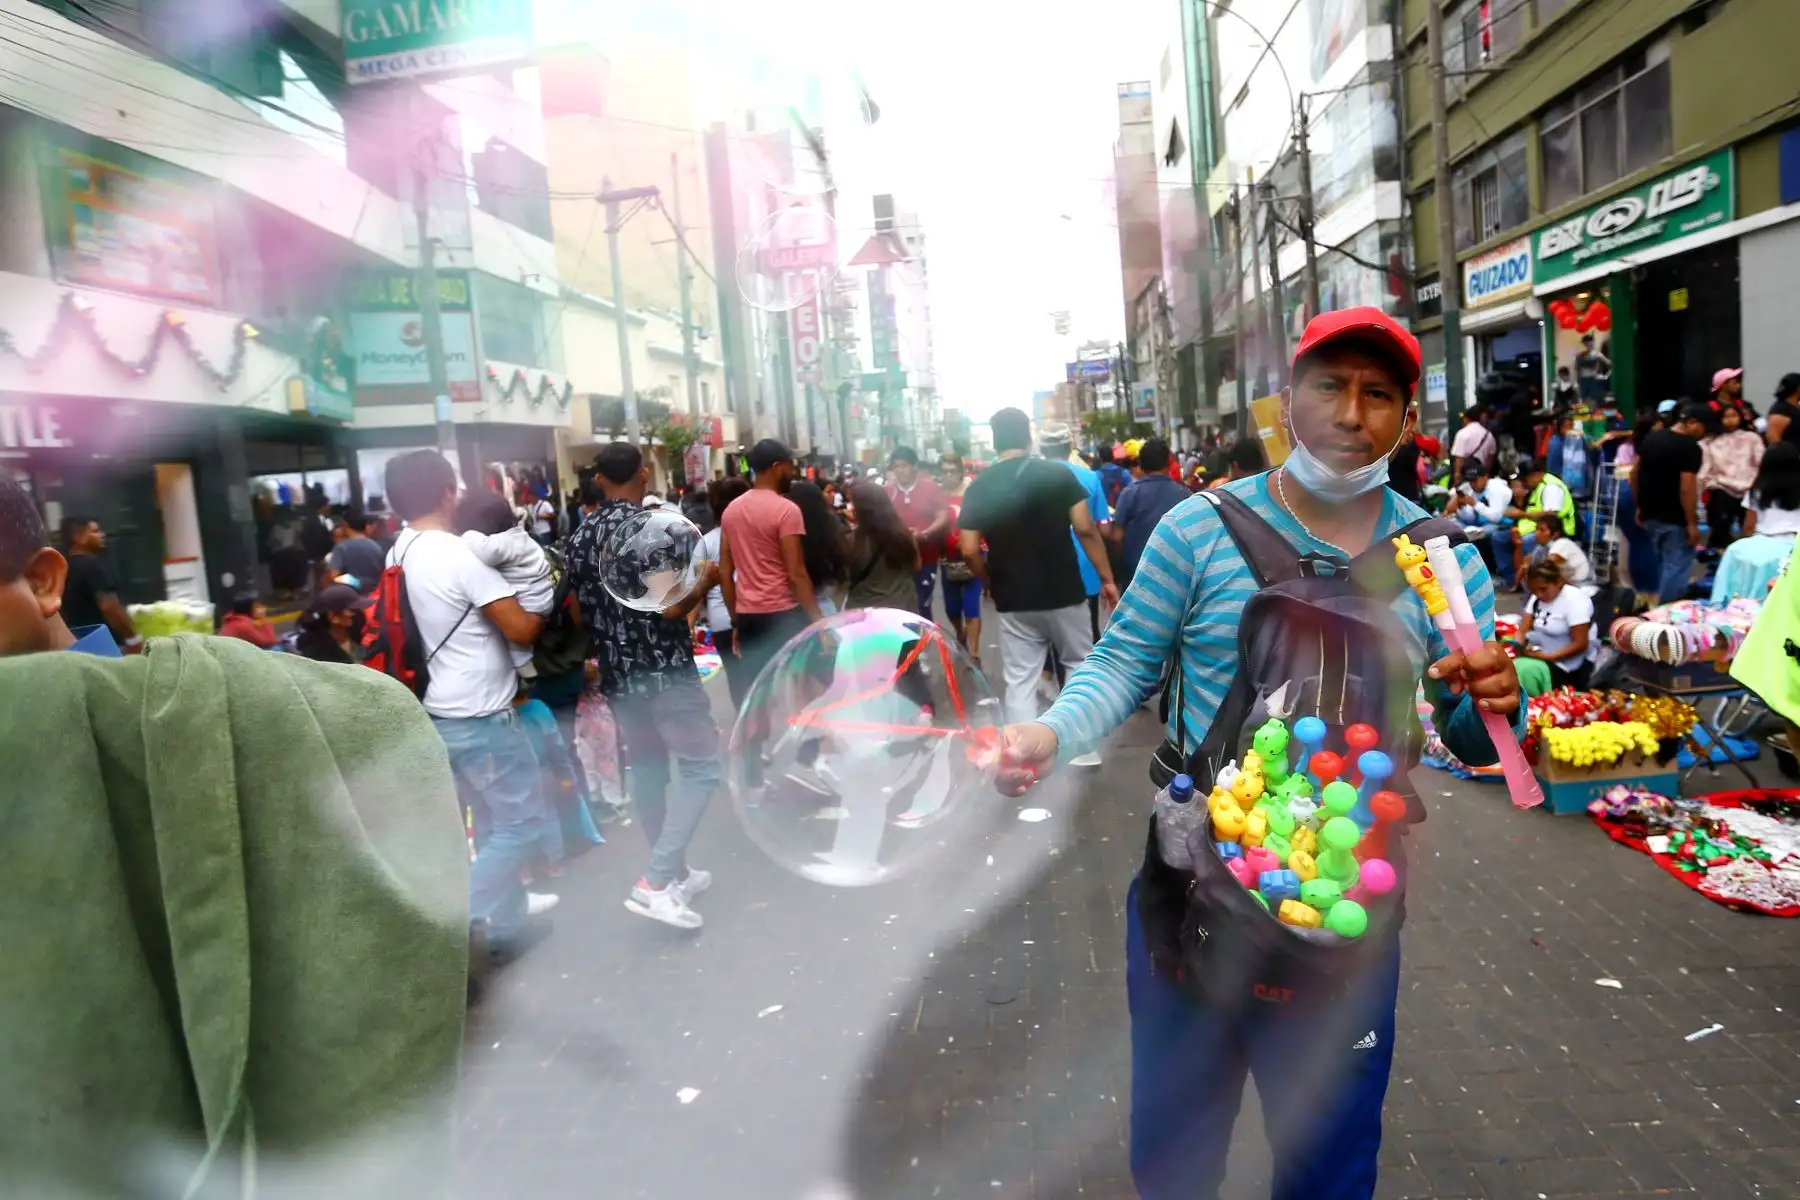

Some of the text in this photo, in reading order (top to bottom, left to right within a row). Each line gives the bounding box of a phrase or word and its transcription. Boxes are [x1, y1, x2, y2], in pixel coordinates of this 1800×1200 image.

[344, 0, 490, 43] GAMAR
[356, 52, 419, 77] MEGA
[1468, 253, 1528, 300] GUIZADO
[360, 350, 465, 367] MoneyGm
[1253, 982, 1297, 1003] CAT
